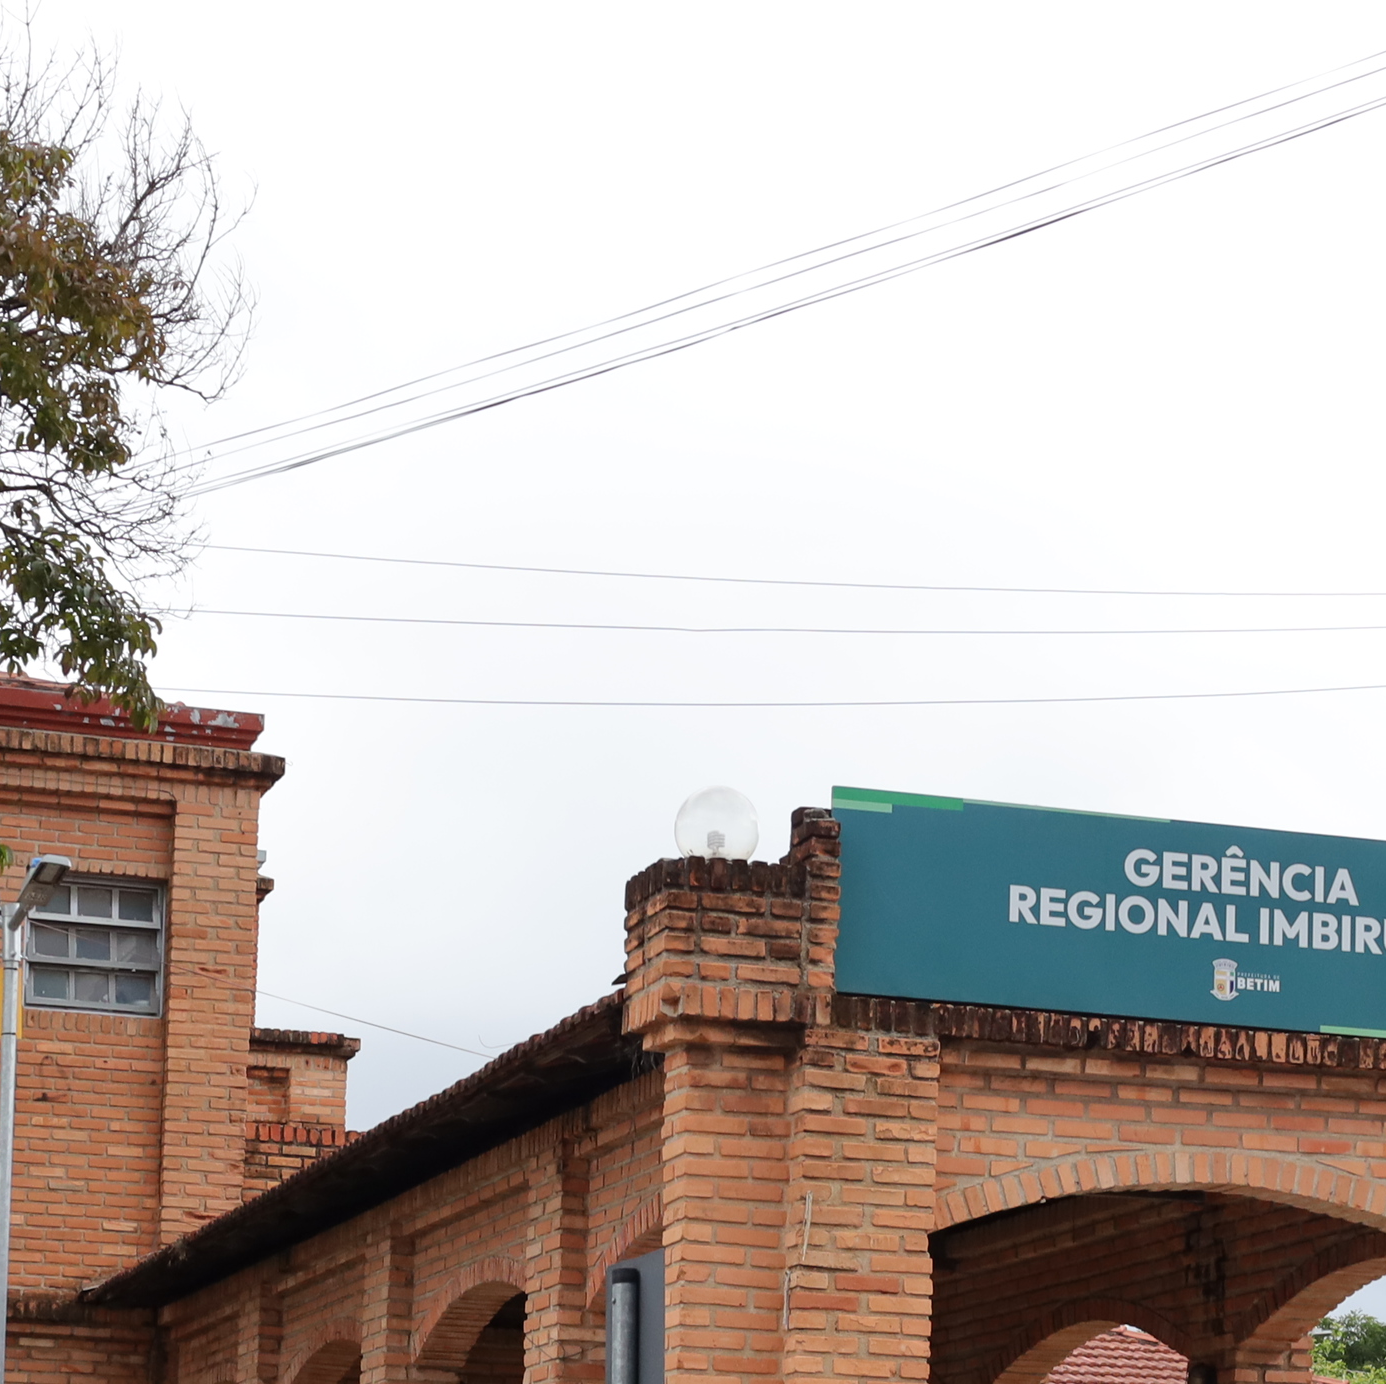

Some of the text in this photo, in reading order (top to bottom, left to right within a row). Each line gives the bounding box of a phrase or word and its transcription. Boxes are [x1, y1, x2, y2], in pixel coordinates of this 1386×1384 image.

[1123, 844, 1360, 907] GERÊNCIA
[1008, 883, 1251, 945] REGIONAL
[1236, 976, 1281, 993] BETIM
